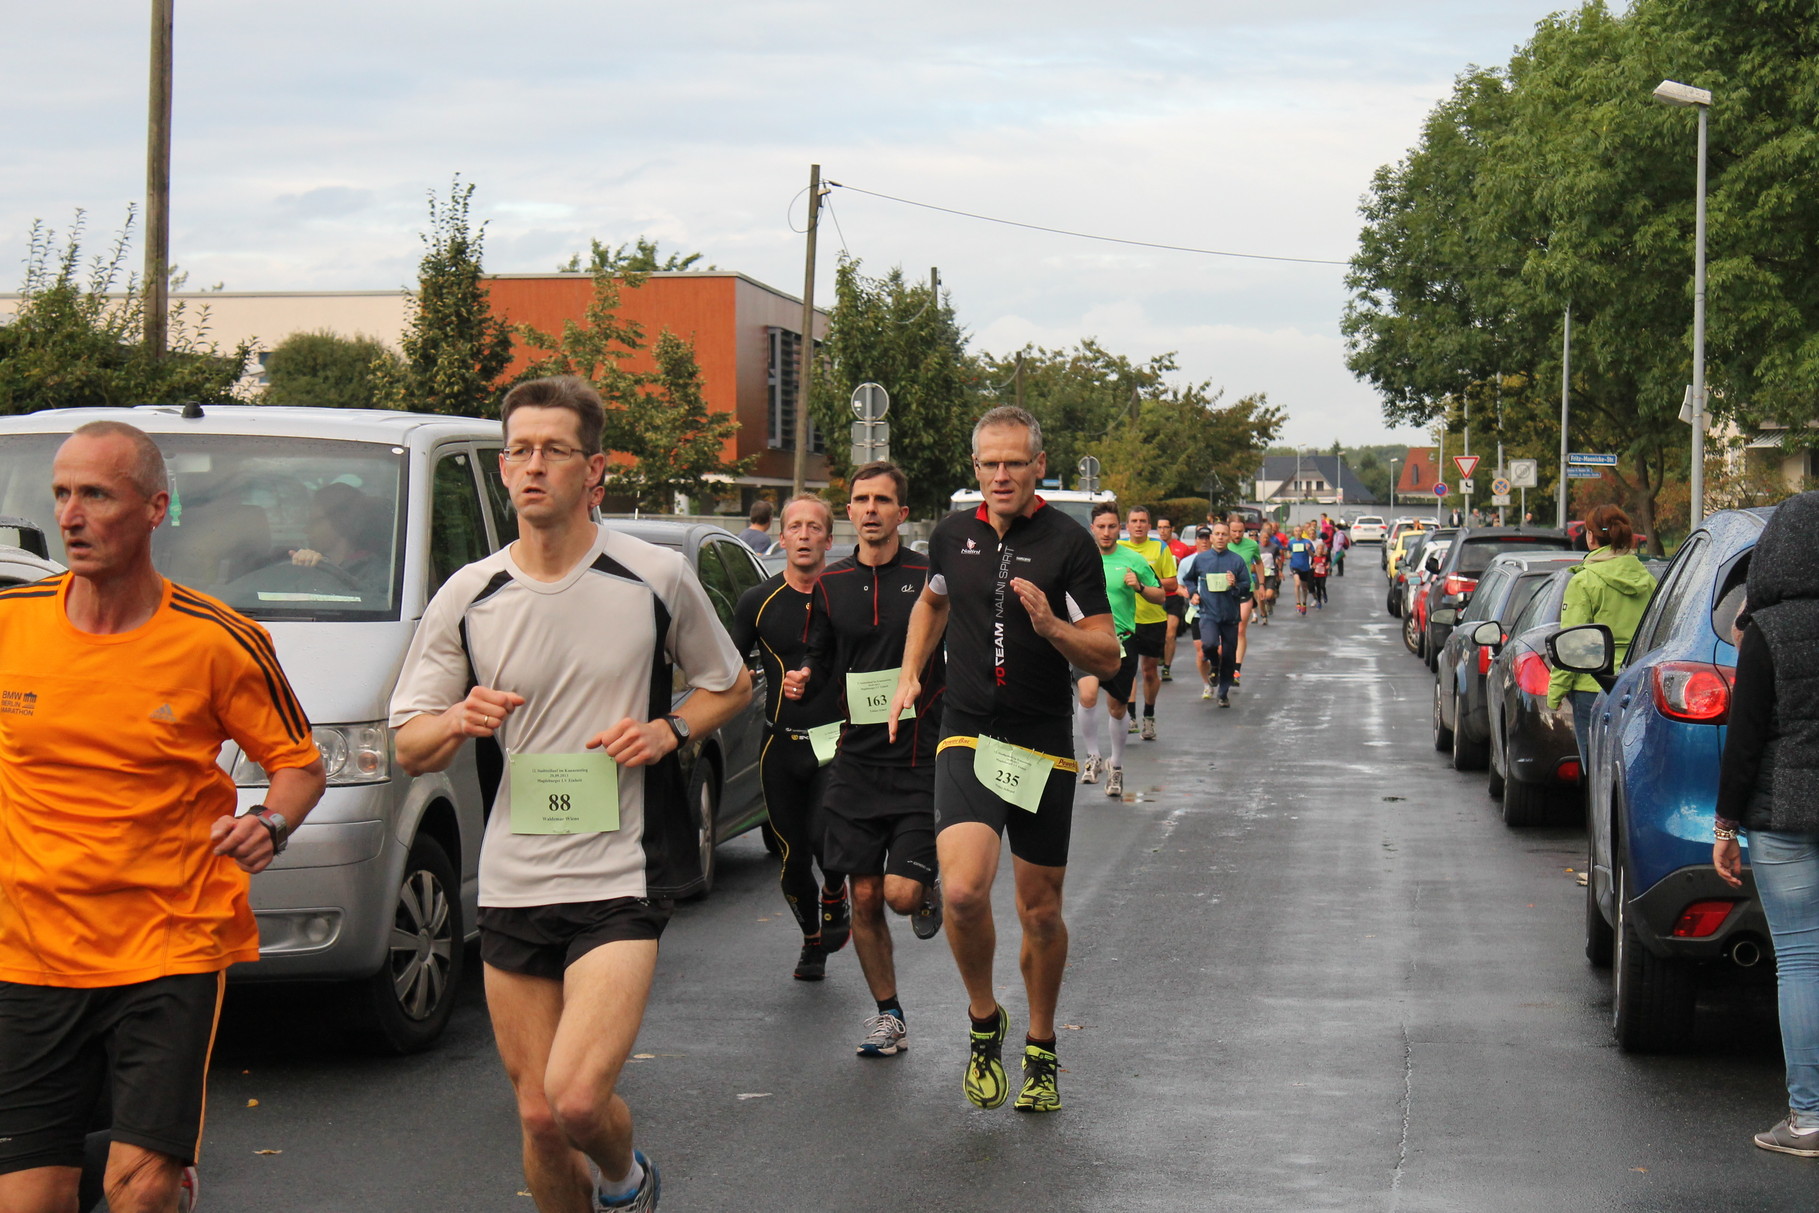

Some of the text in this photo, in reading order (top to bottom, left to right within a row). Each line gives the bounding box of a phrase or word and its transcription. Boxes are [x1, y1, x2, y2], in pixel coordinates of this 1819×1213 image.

[998, 545, 1015, 579] SPIRIT
[994, 581, 1006, 618] NALINI
[2, 690, 22, 700] BMW
[867, 694, 888, 707] 163
[1, 699, 21, 707] BERLIN
[0, 707, 33, 716] MARATHON
[995, 769, 1020, 787] 235
[548, 793, 571, 811] 88
